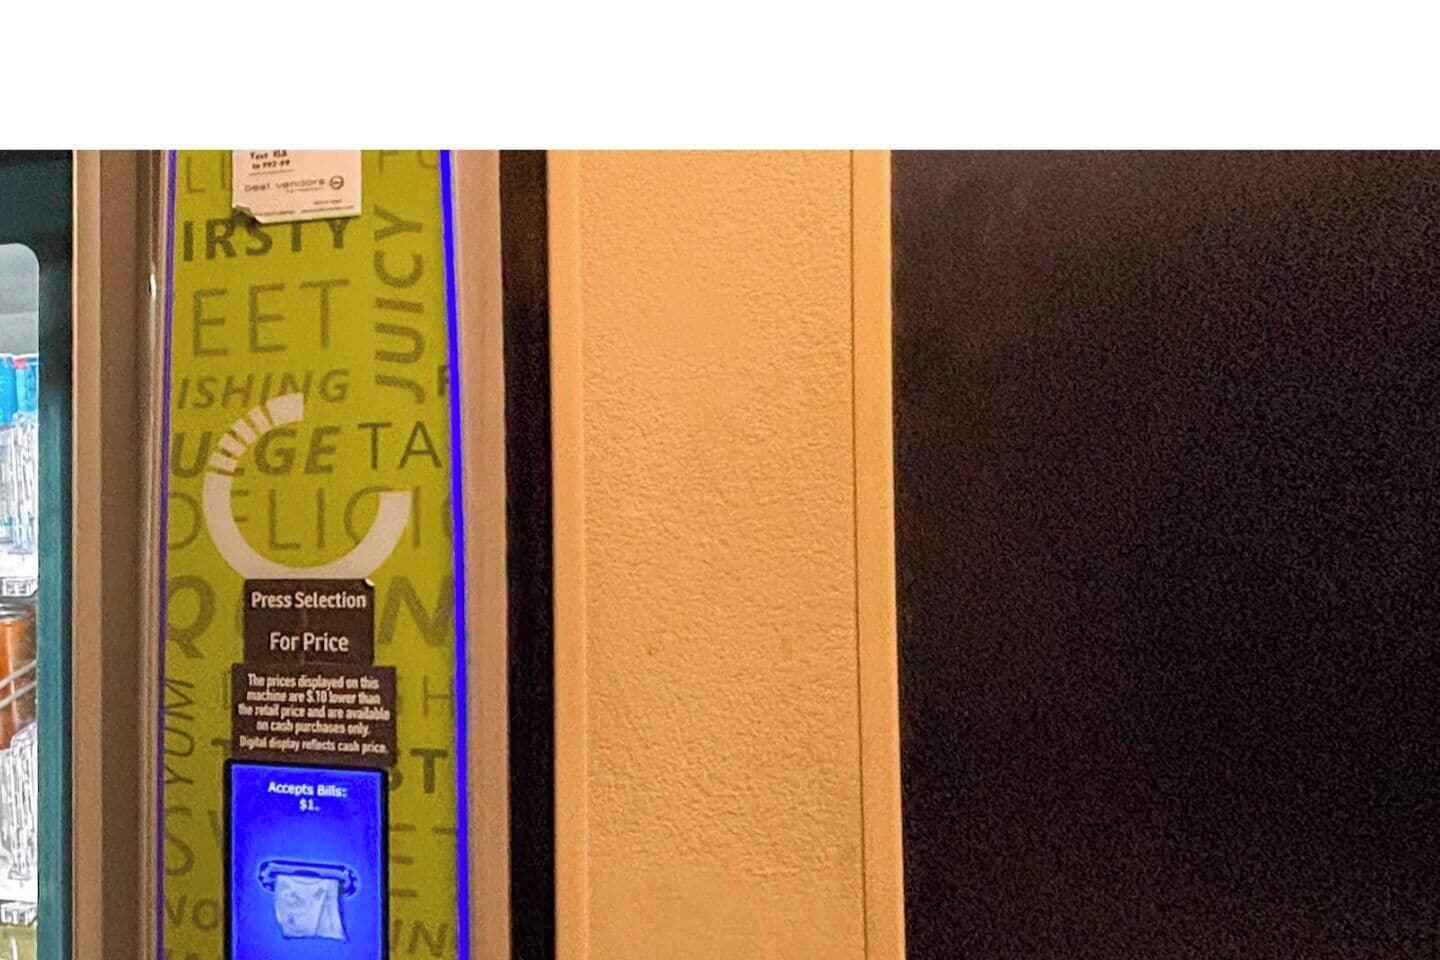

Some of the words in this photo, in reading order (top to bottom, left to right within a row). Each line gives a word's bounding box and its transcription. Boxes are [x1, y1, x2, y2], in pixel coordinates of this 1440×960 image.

[373, 203, 426, 405] JUICY
[251, 591, 292, 608] Press
[294, 591, 367, 608] Selection
[270, 632, 299, 651] For
[303, 632, 349, 652] Price
[247, 673, 265, 686] The
[266, 674, 296, 692] prices
[298, 675, 344, 691] displayed
[345, 678, 358, 689] on
[360, 676, 380, 689] this
[246, 689, 287, 702] machine
[288, 692, 305, 702] are
[306, 690, 327, 703] $.10
[328, 691, 356, 703] lower
[358, 691, 381, 704] than
[238, 703, 253, 715] the
[254, 703, 279, 716] retail
[280, 704, 305, 719] price
[307, 705, 326, 718] and
[327, 707, 344, 719] are
[345, 707, 390, 721] available
[256, 720, 269, 731] on
[270, 720, 293, 732] cash
[295, 721, 345, 735] purchases
[239, 736, 268, 750] Digital
[269, 737, 300, 751] display
[302, 738, 336, 752] reflects
[337, 740, 360, 753] cash
[267, 781, 314, 797] Accepts
[317, 784, 347, 798] Bills:
